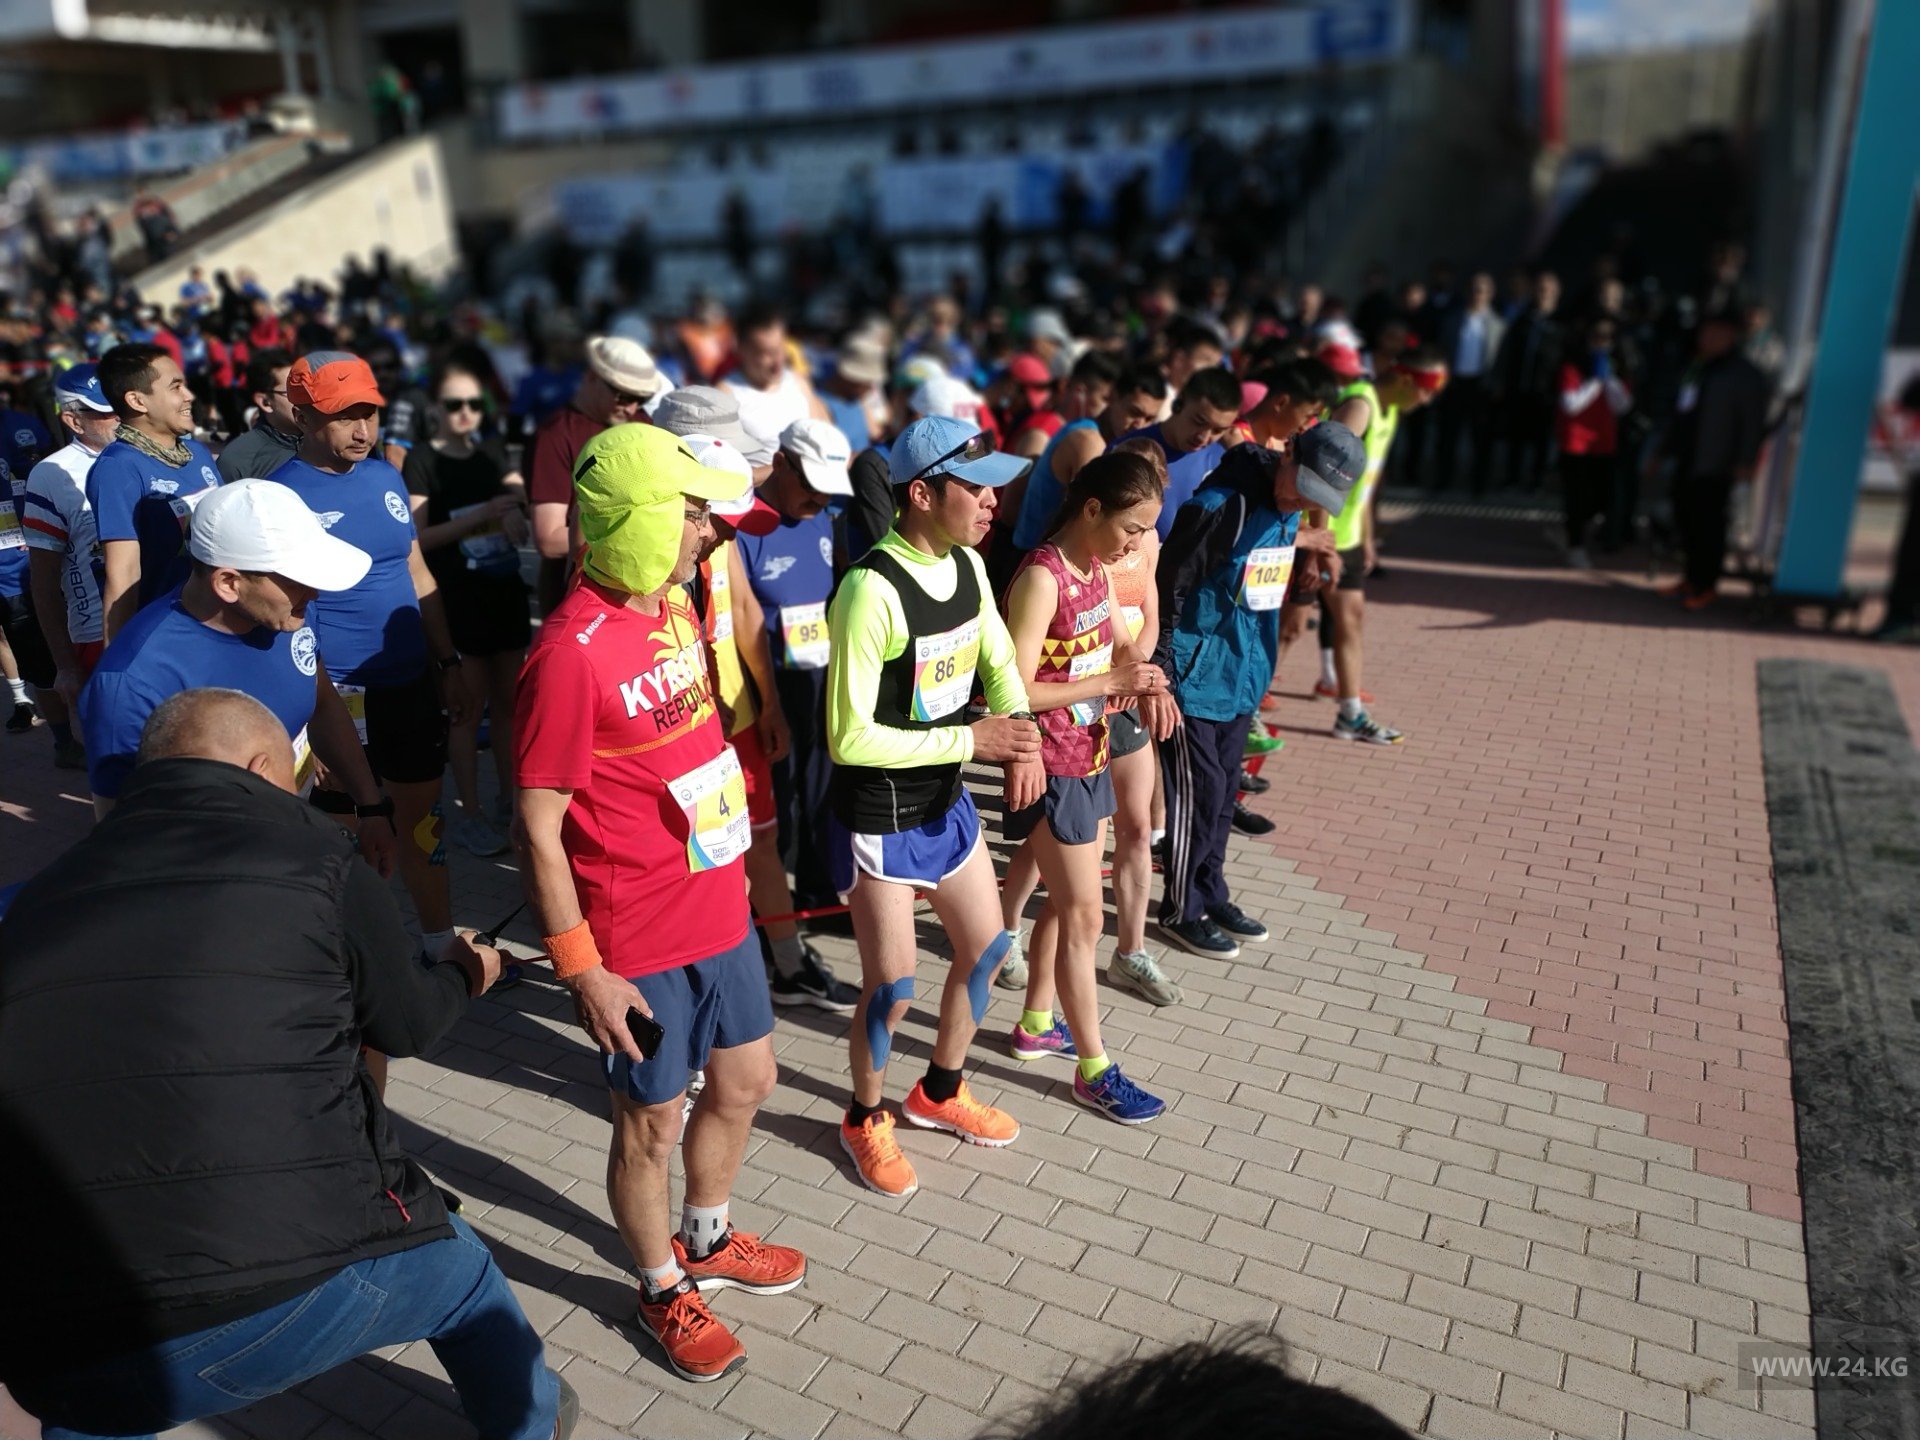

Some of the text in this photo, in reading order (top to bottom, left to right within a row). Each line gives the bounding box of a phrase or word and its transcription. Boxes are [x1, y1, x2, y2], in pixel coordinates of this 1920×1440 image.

[1255, 566, 1281, 584] 102
[799, 623, 819, 643] 95
[934, 655, 955, 683] 86
[719, 791, 731, 817] 4
